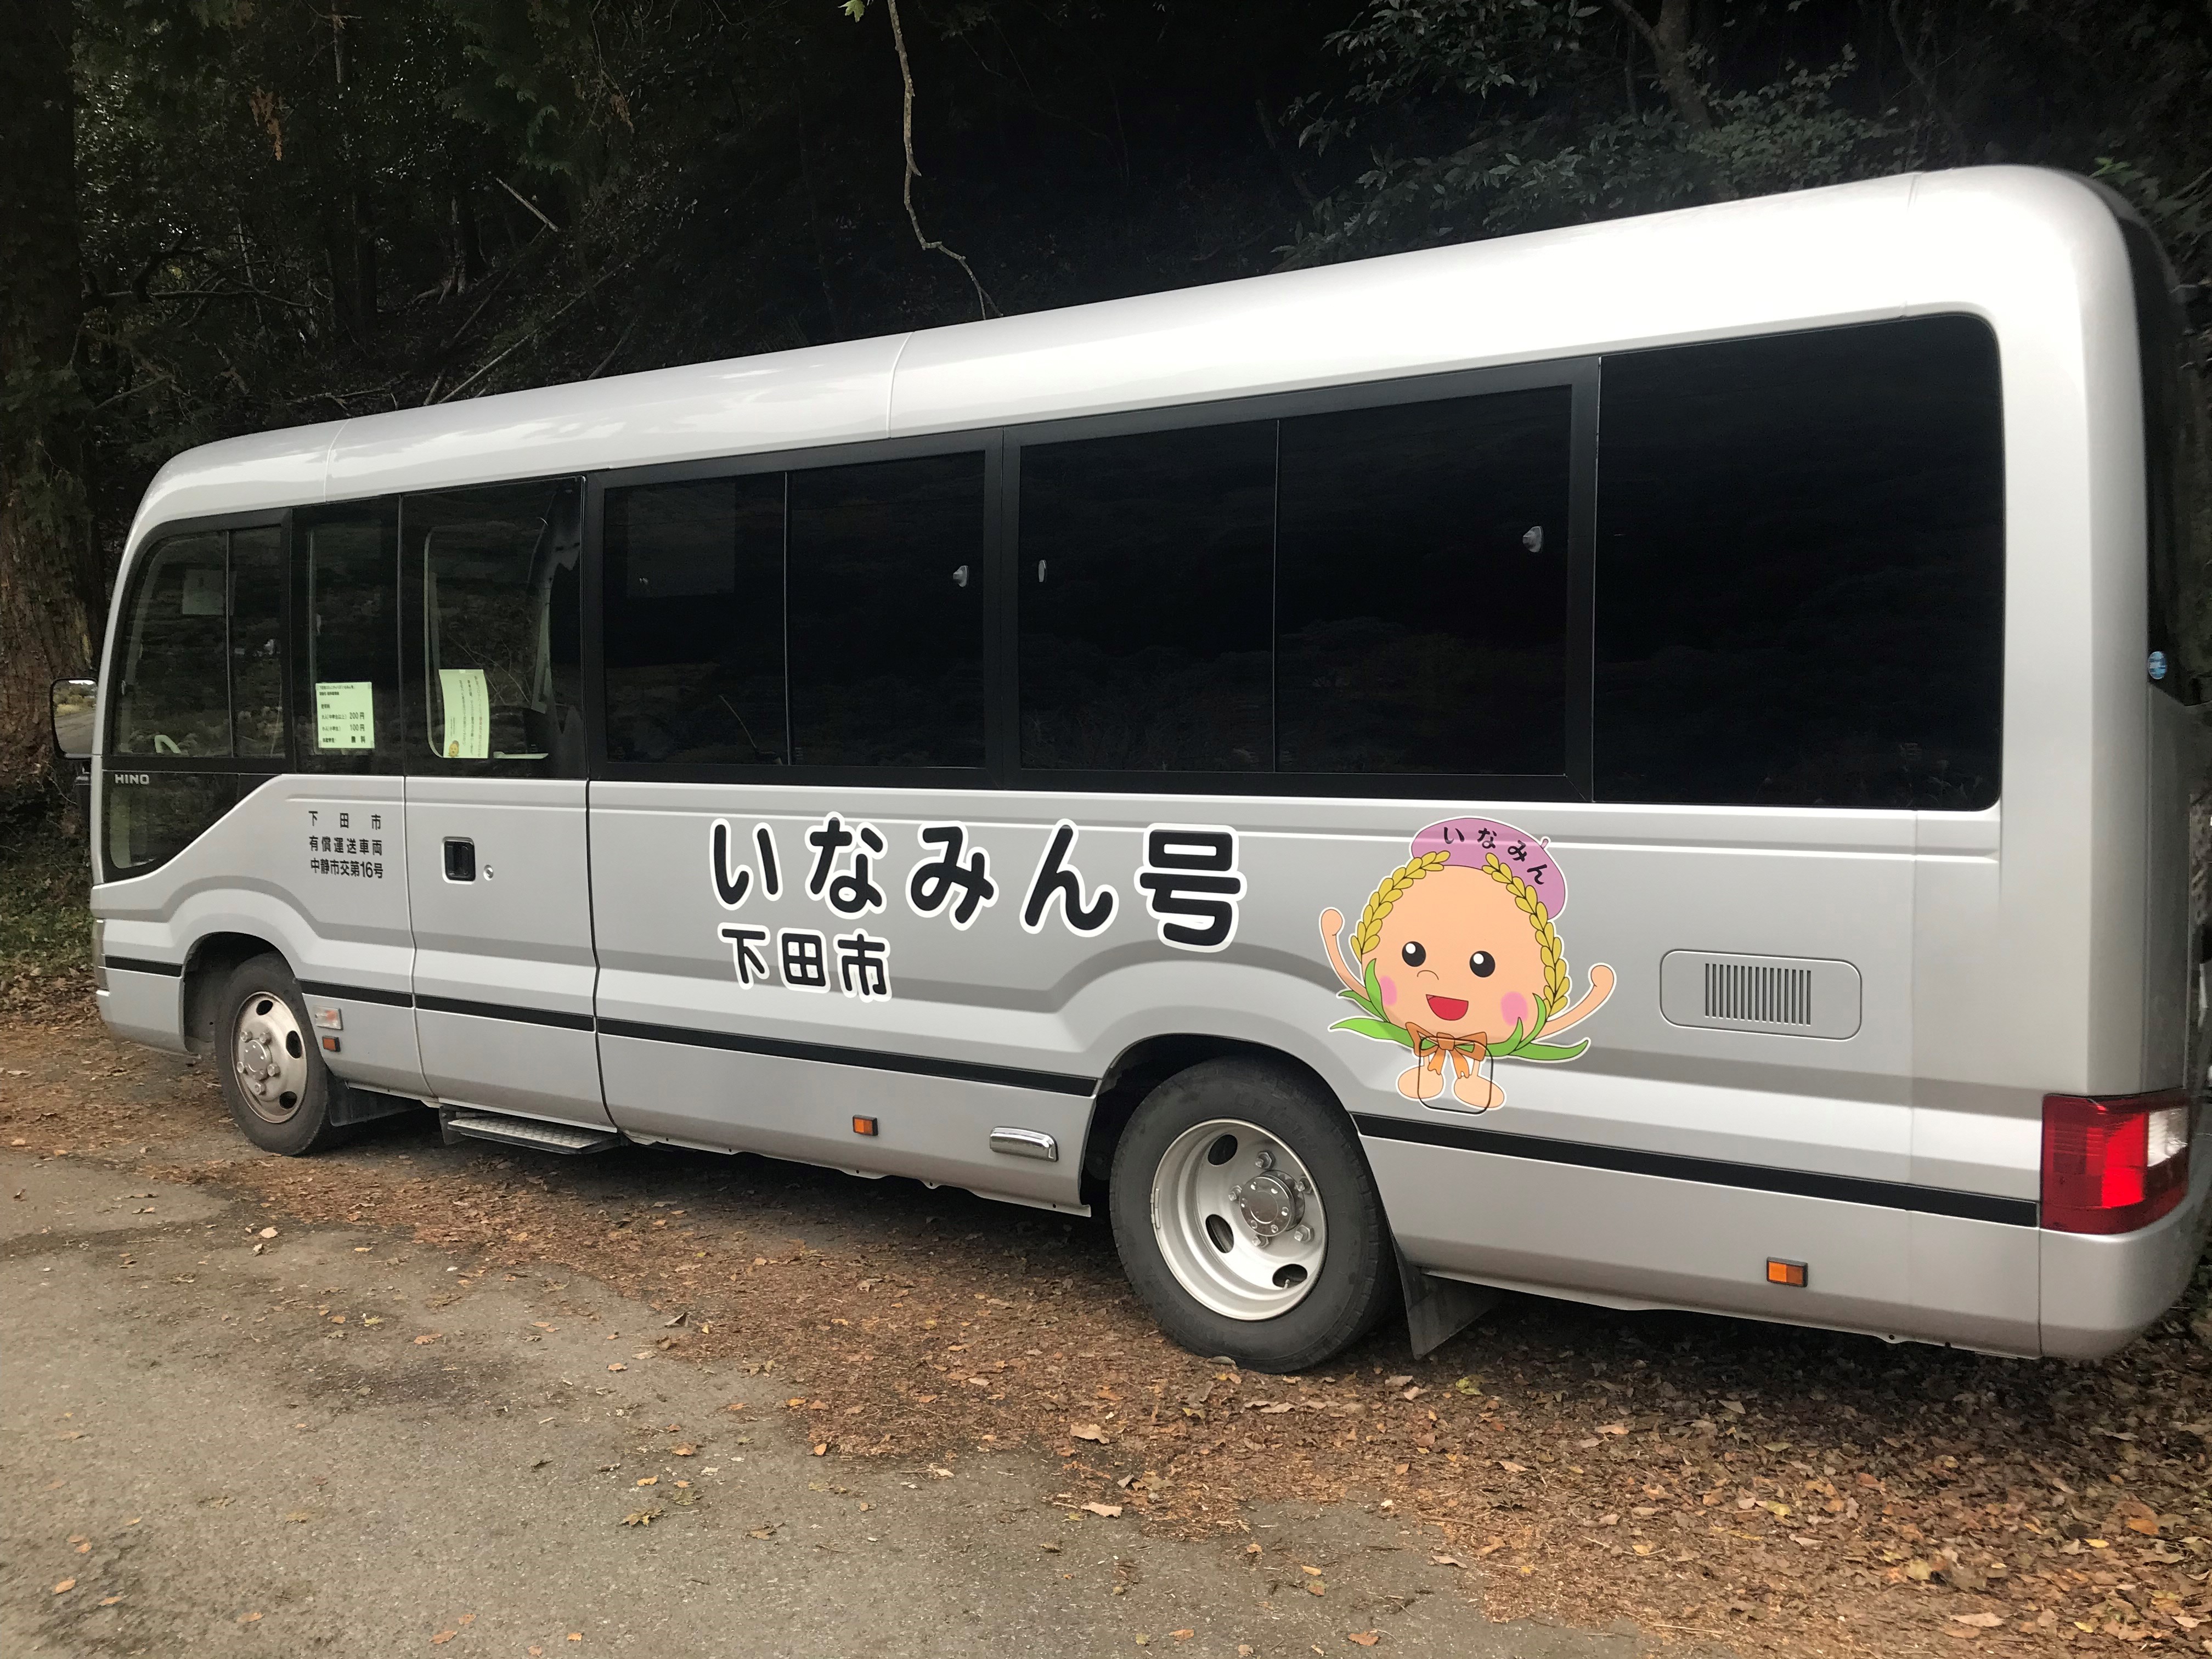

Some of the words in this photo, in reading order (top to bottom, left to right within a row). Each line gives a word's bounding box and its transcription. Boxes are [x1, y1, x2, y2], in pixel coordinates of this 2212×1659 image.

[115, 774, 149, 785] HINO
[308, 810, 381, 830] 下田市
[309, 835, 382, 856] 有償運送車両
[1443, 826, 1548, 885] いなみん
[311, 857, 383, 878] 中静市交第16号
[708, 814, 1244, 949] いなみん号
[720, 926, 889, 998] 下田市
